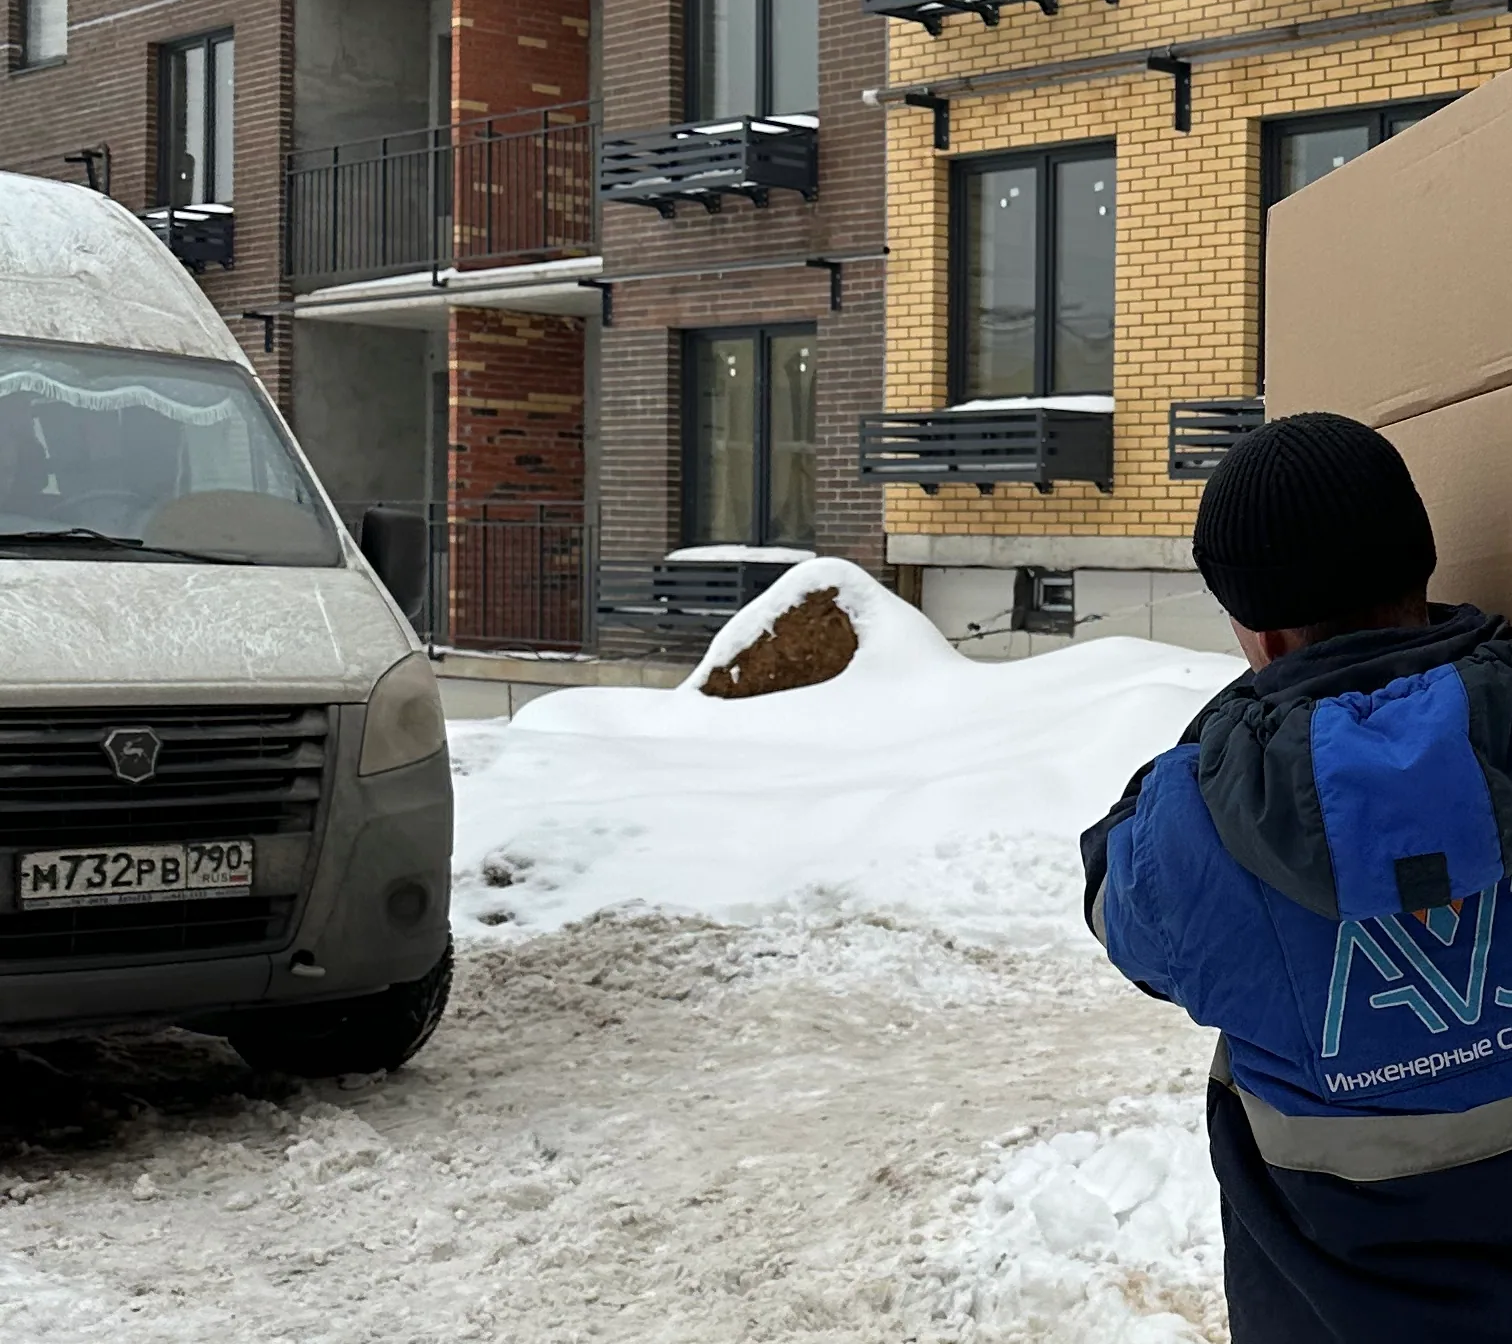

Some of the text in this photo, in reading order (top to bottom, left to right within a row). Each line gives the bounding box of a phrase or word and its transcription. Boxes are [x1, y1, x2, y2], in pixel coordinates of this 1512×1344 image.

[188, 845, 242, 874] 790
[202, 872, 229, 884] RUS
[1324, 1037, 1494, 1093] Инженерные
